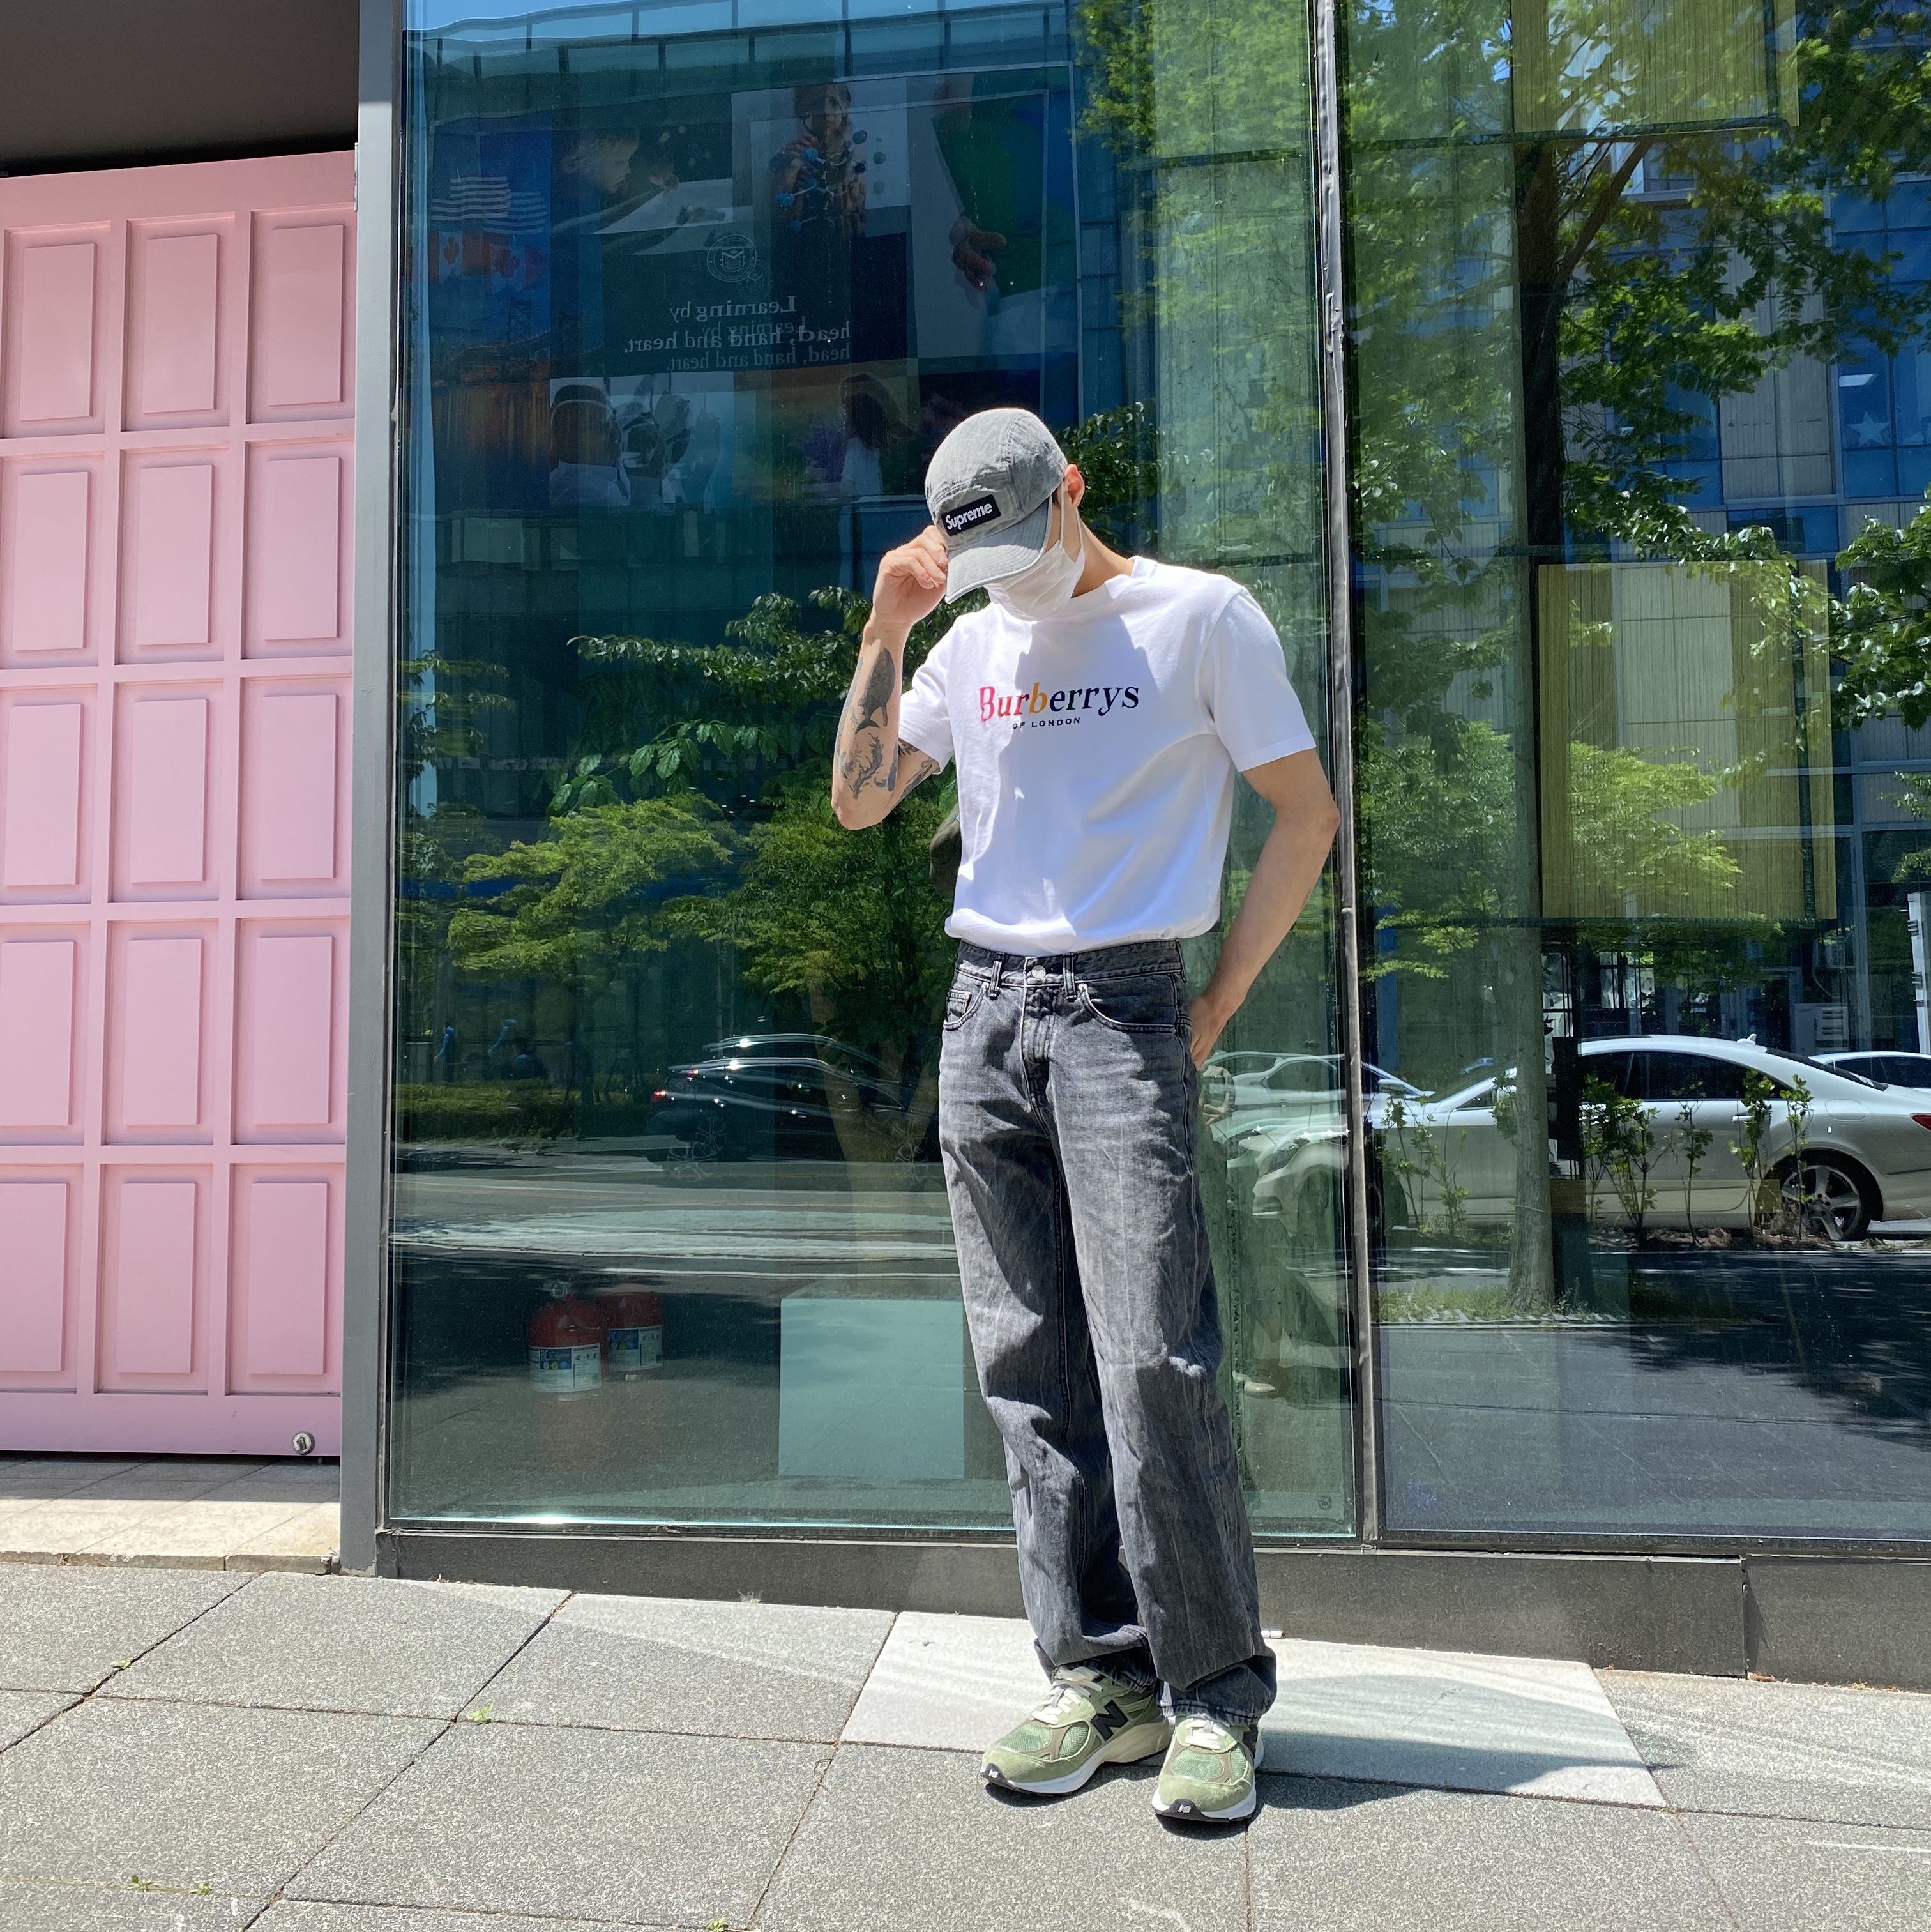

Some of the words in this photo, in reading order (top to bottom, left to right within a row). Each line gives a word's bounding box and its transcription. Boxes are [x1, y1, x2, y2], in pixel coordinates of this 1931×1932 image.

[944, 501, 993, 531] Supreme
[978, 681, 1140, 724] Burberrys
[1011, 722, 1026, 730] OF
[1031, 717, 1082, 729] LONDON
